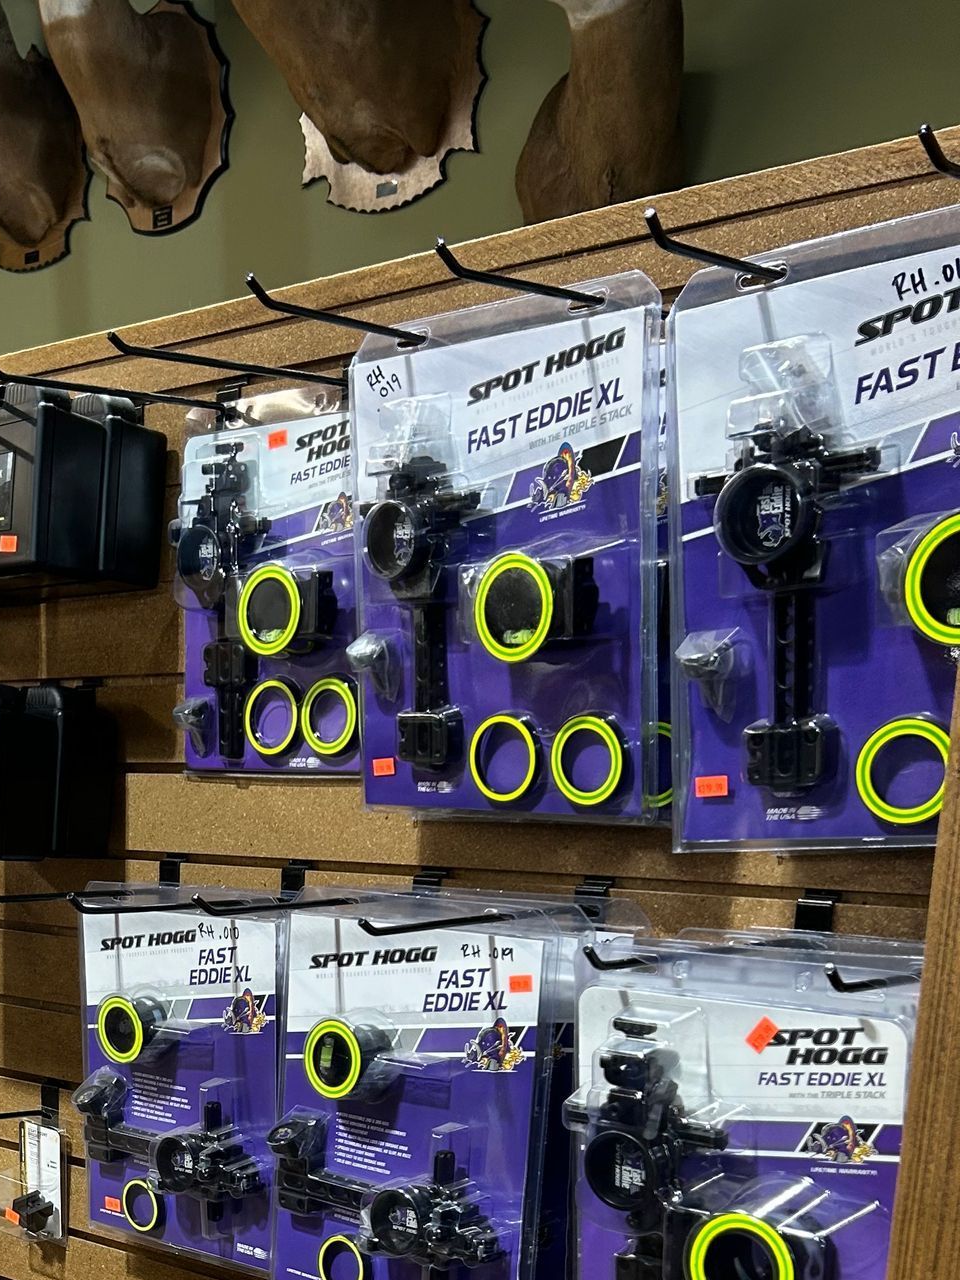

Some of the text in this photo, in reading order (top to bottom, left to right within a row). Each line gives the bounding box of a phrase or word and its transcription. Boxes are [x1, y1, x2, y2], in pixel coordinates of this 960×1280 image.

[892, 267, 928, 301] RH
[854, 286, 960, 348] SPOT
[366, 365, 385, 391] RH
[467, 327, 626, 407] SPOT HOGG
[854, 346, 947, 405] FAST
[379, 373, 402, 398] 019
[467, 377, 624, 455] FAST EDDIE XL
[528, 404, 633, 450] WITH THE TRIPLE STACK
[294, 419, 350, 452] SPOT
[307, 434, 351, 463] HOG
[290, 454, 351, 486] FAST EDDIE
[100, 929, 197, 952] SPOT HOGG
[198, 922, 215, 940] RH
[198, 946, 238, 966] FAST
[308, 946, 438, 969] SPOT HOGG
[460, 944, 481, 958] RH
[189, 965, 252, 986] EDDIE XL
[437, 967, 491, 989] FAST
[422, 990, 509, 1013] EDDIE XL
[768, 1027, 865, 1048] SPOT
[786, 1047, 888, 1066] HOGG
[757, 1072, 888, 1086] FAST EDDIE XL
[820, 1091, 853, 1099] TRIPLE
[855, 1090, 886, 1099] STACK
